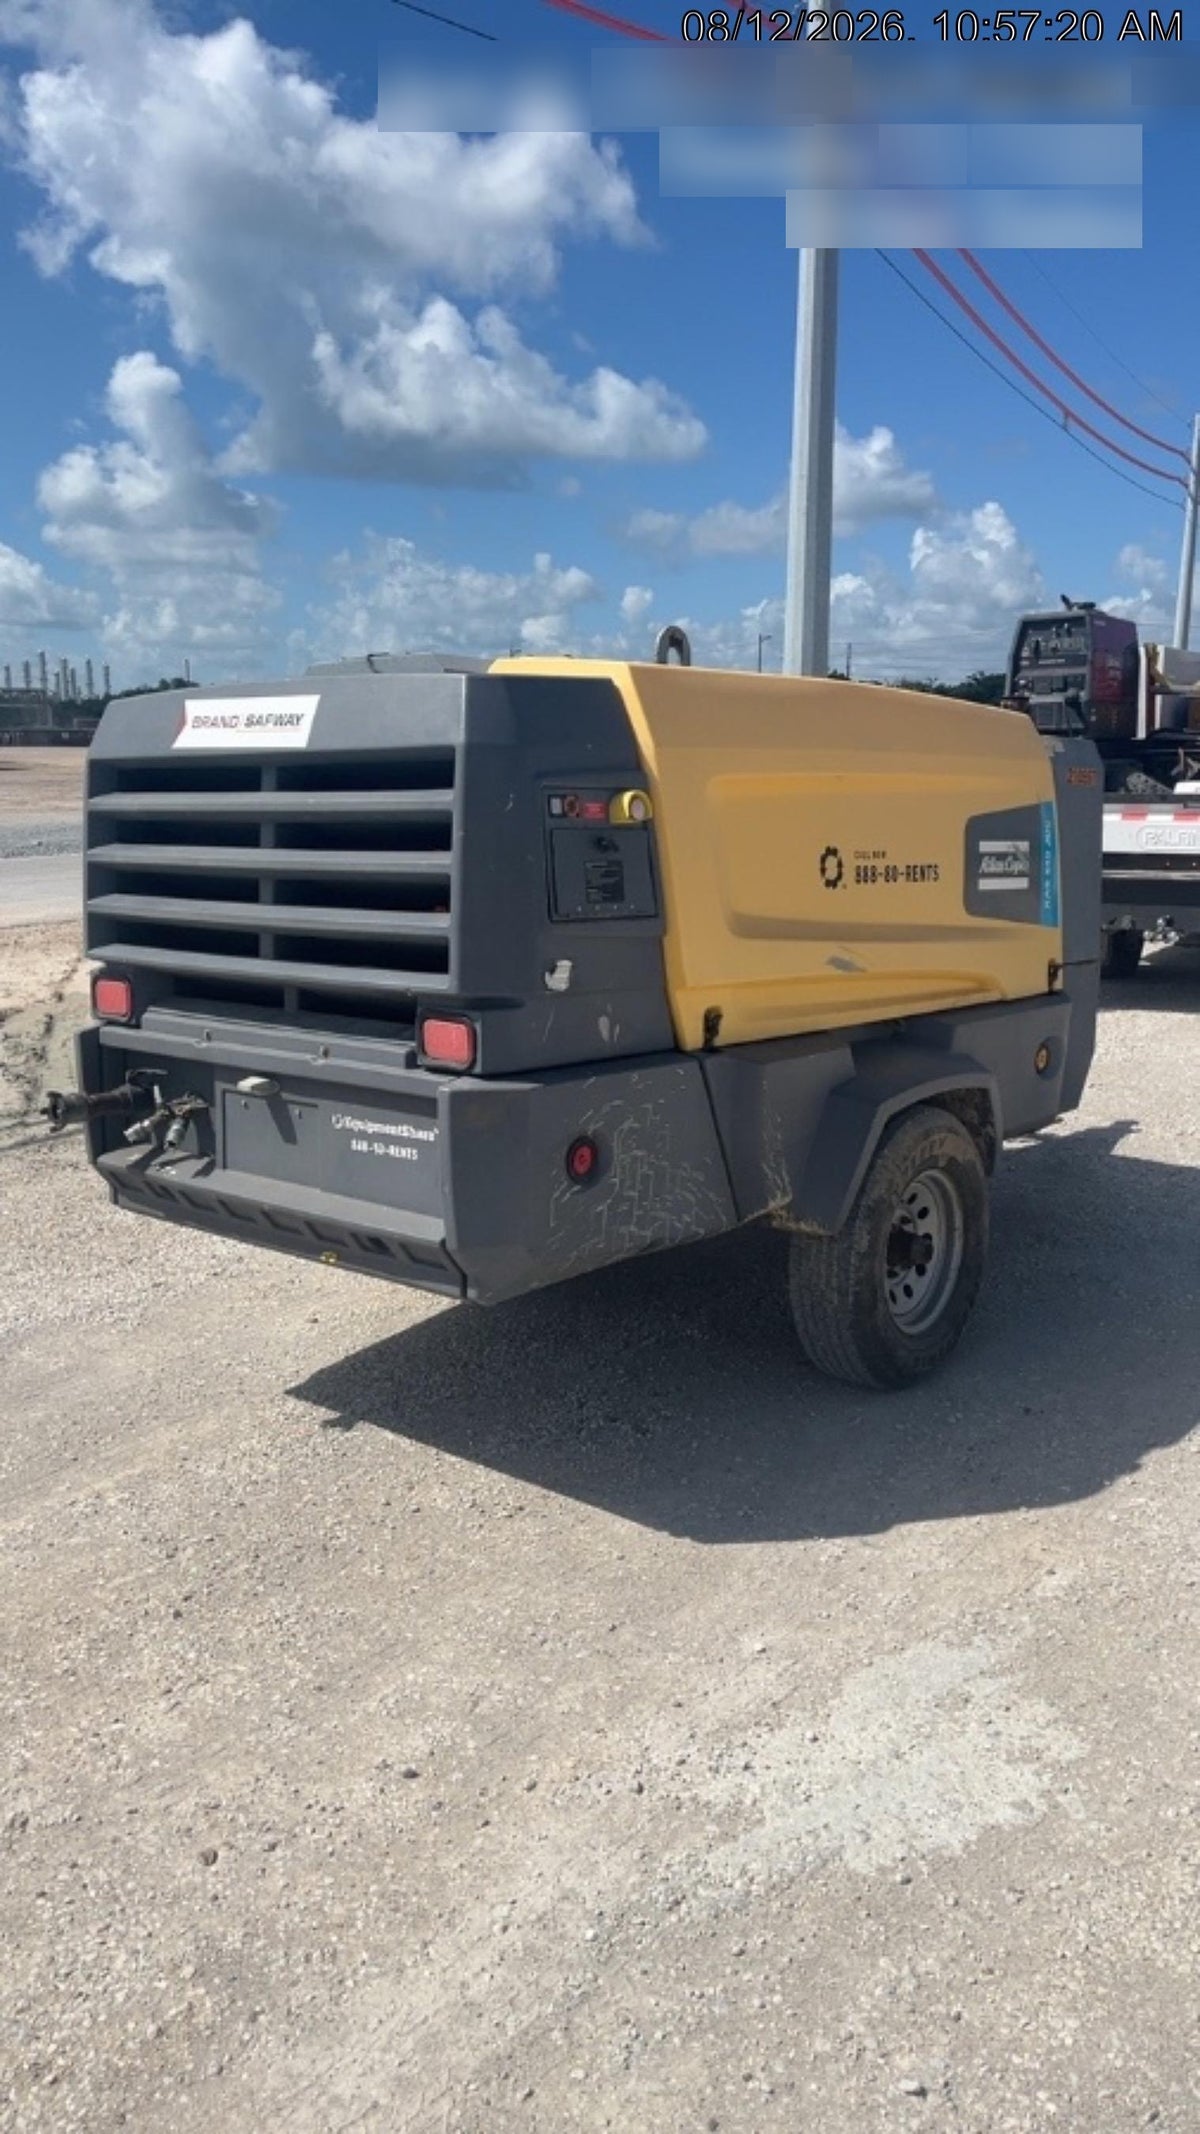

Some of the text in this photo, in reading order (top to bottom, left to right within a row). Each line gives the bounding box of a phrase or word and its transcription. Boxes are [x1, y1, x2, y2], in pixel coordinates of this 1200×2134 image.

[192, 713, 305, 729] BRAND SAFWAY
[855, 864, 940, 885] 888-80-RENTS
